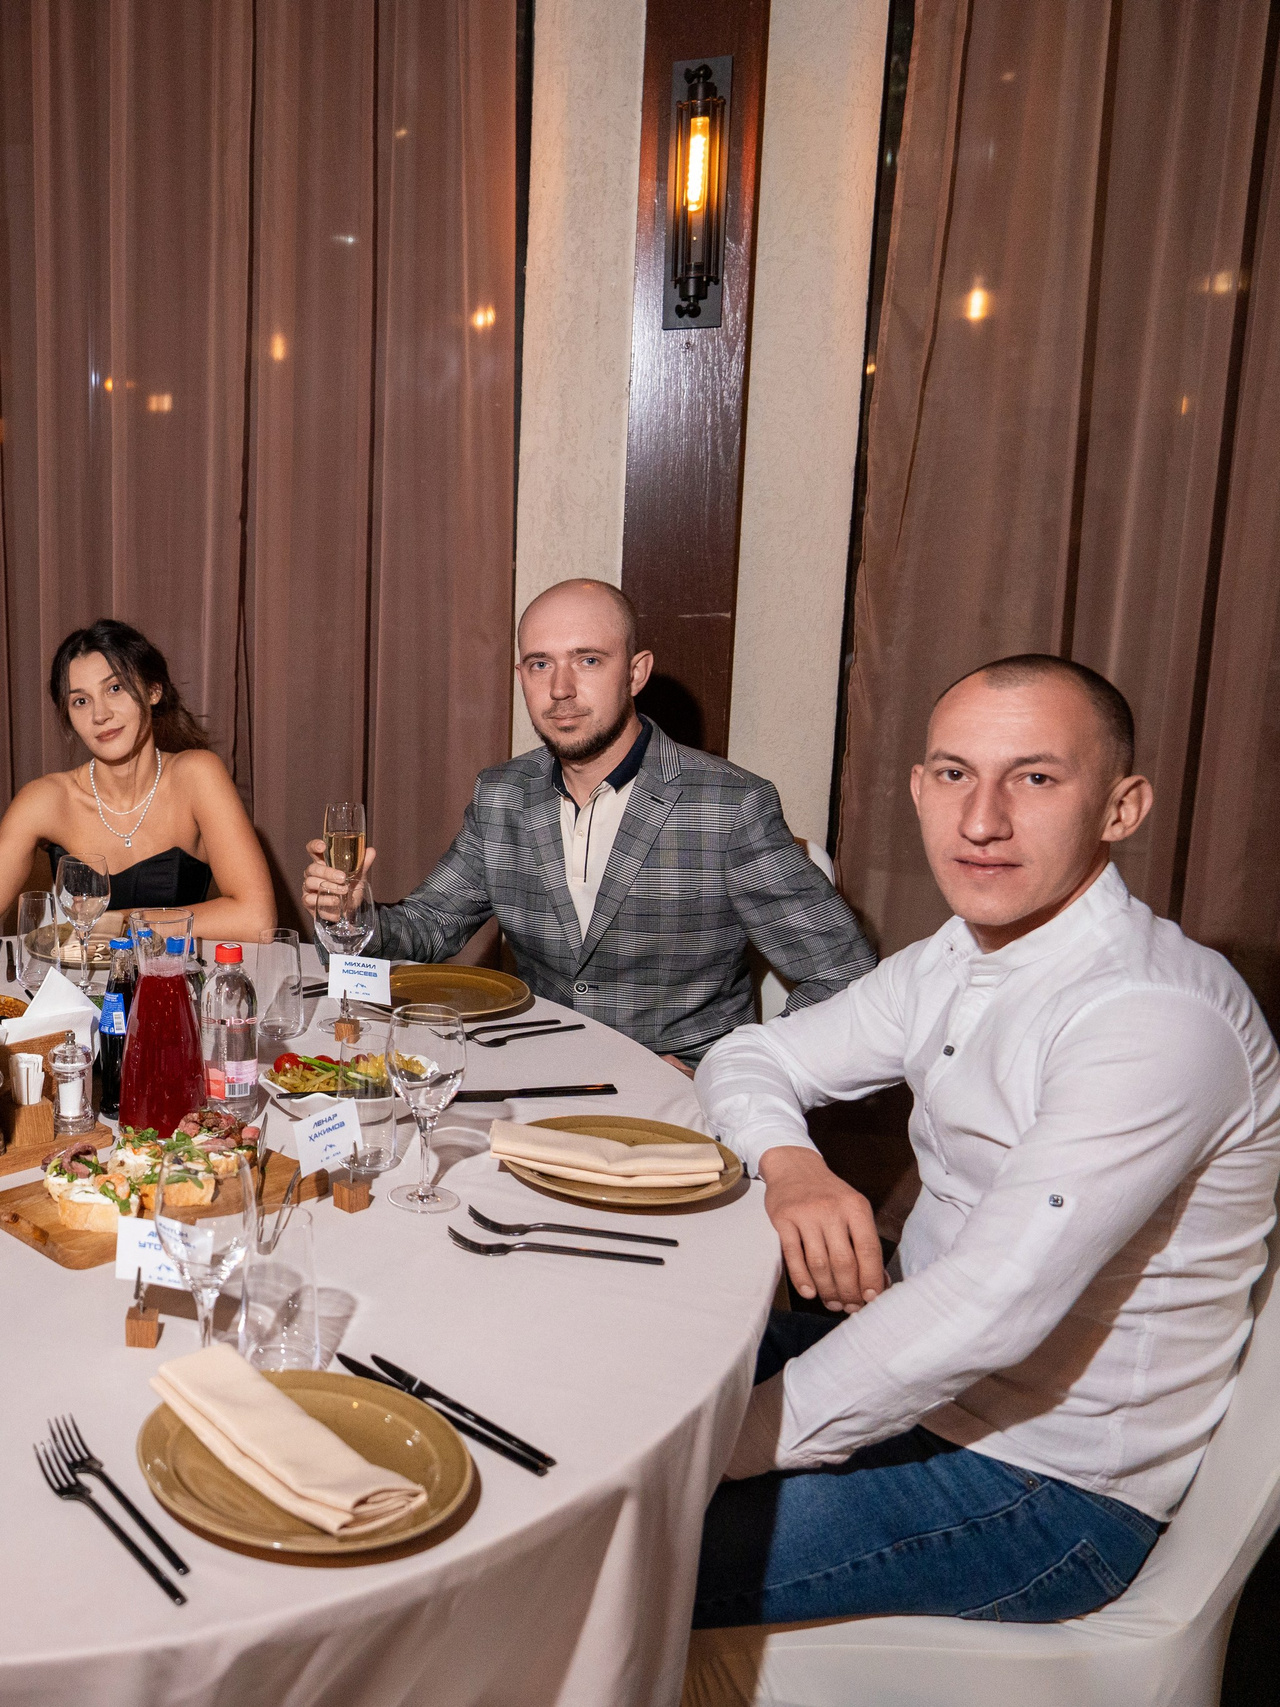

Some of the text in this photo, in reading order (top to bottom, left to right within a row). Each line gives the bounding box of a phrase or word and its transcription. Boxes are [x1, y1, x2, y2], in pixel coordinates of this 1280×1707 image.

[344, 961, 376, 969] МИХАИЛ
[342, 969, 378, 978] МОИСЕЕВ
[312, 1113, 338, 1129] ЛЕНАР
[308, 1121, 346, 1142] ХАКИМОВ
